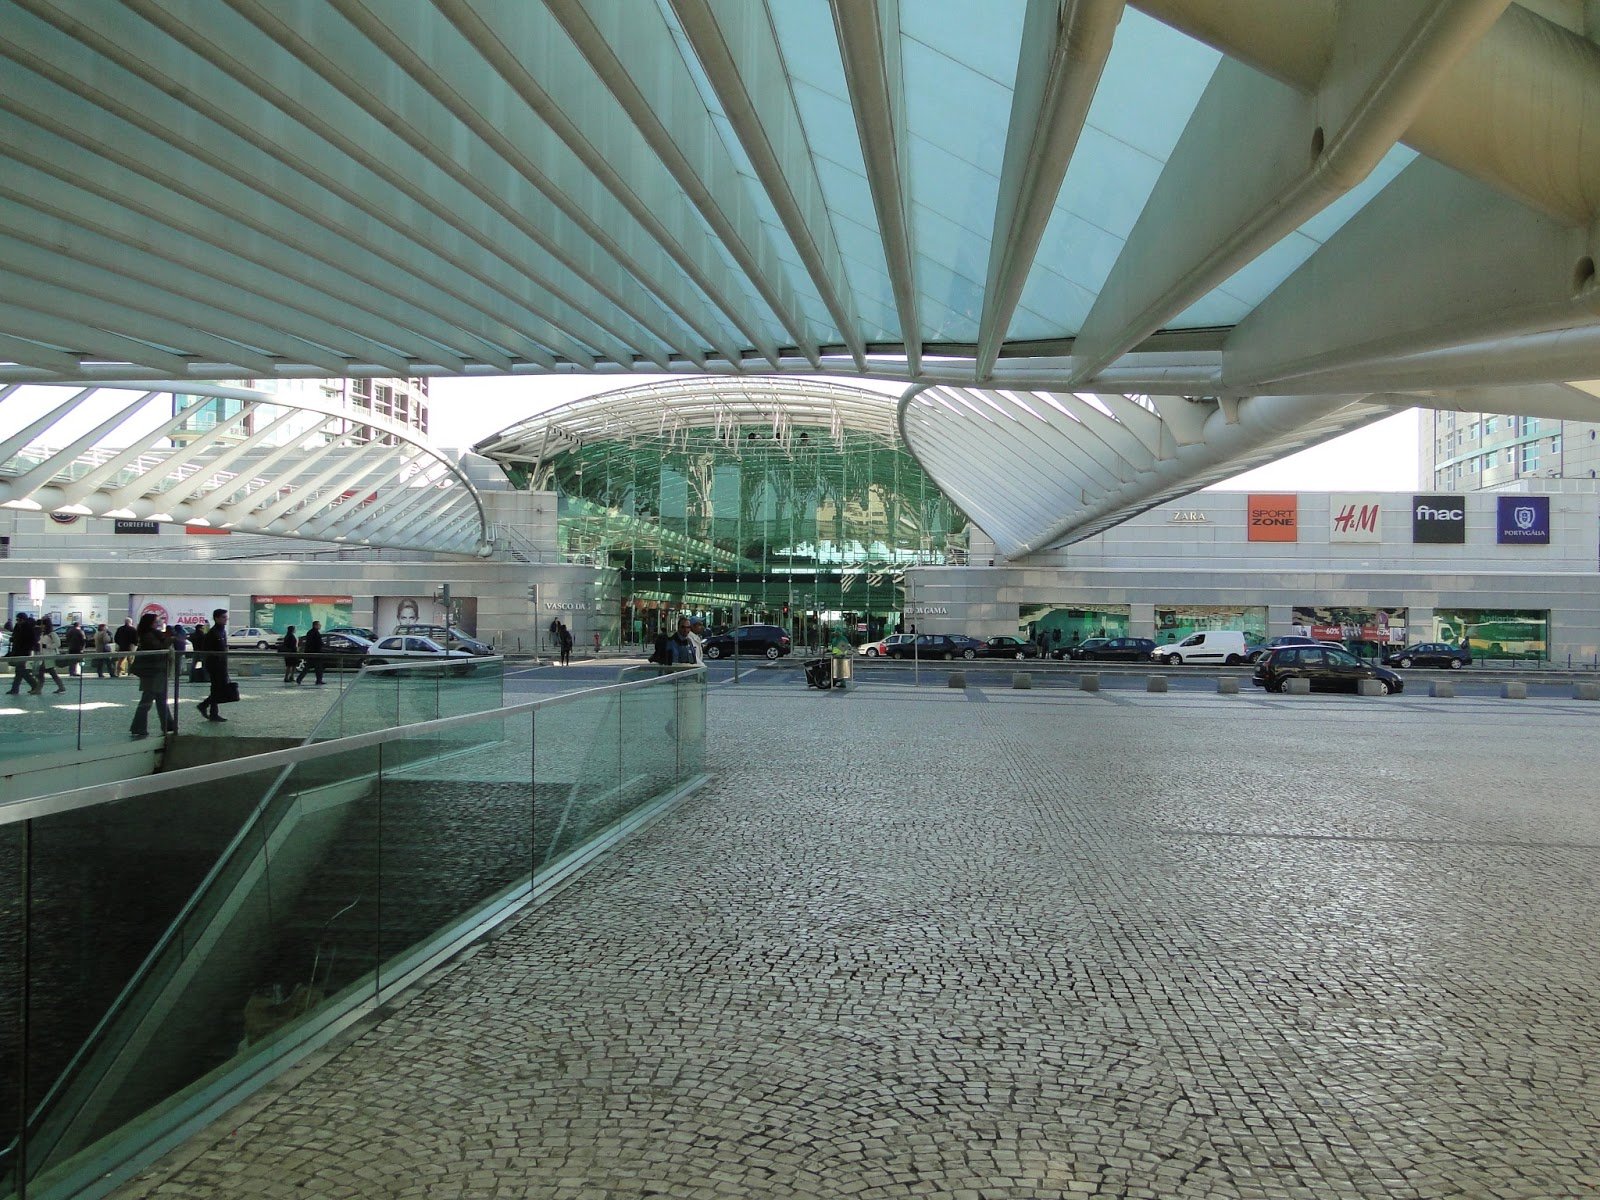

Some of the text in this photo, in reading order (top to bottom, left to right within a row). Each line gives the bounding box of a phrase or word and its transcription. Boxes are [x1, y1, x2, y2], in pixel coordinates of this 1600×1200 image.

[1173, 511, 1207, 521] ZARA
[1252, 509, 1294, 518] SPORT
[1416, 505, 1463, 521] fnac
[1252, 518, 1294, 526] ZONE
[1334, 504, 1380, 533] H&M
[546, 602, 586, 610] VASCO DA
[177, 616, 206, 624] AMOR
[1325, 627, 1340, 635] 60%
